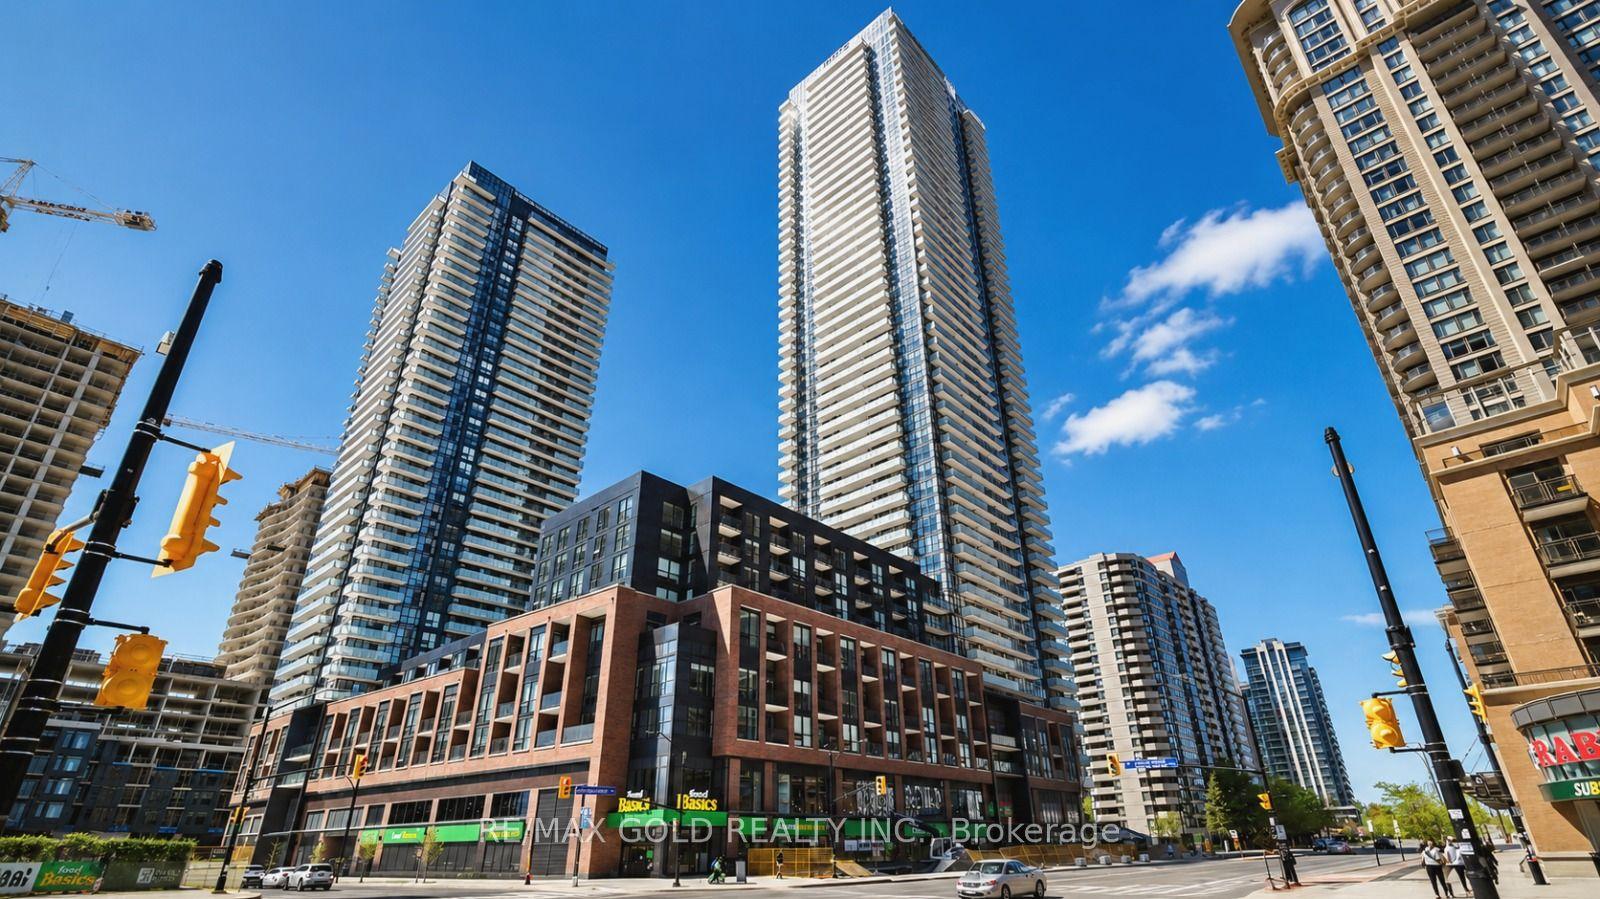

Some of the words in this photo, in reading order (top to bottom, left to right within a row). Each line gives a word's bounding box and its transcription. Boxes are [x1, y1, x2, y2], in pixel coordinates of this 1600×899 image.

[1532, 729, 1600, 768] RAB
[1574, 781, 1600, 796] SUB
[676, 793, 717, 811] Basics
[40, 872, 96, 886] Basics
